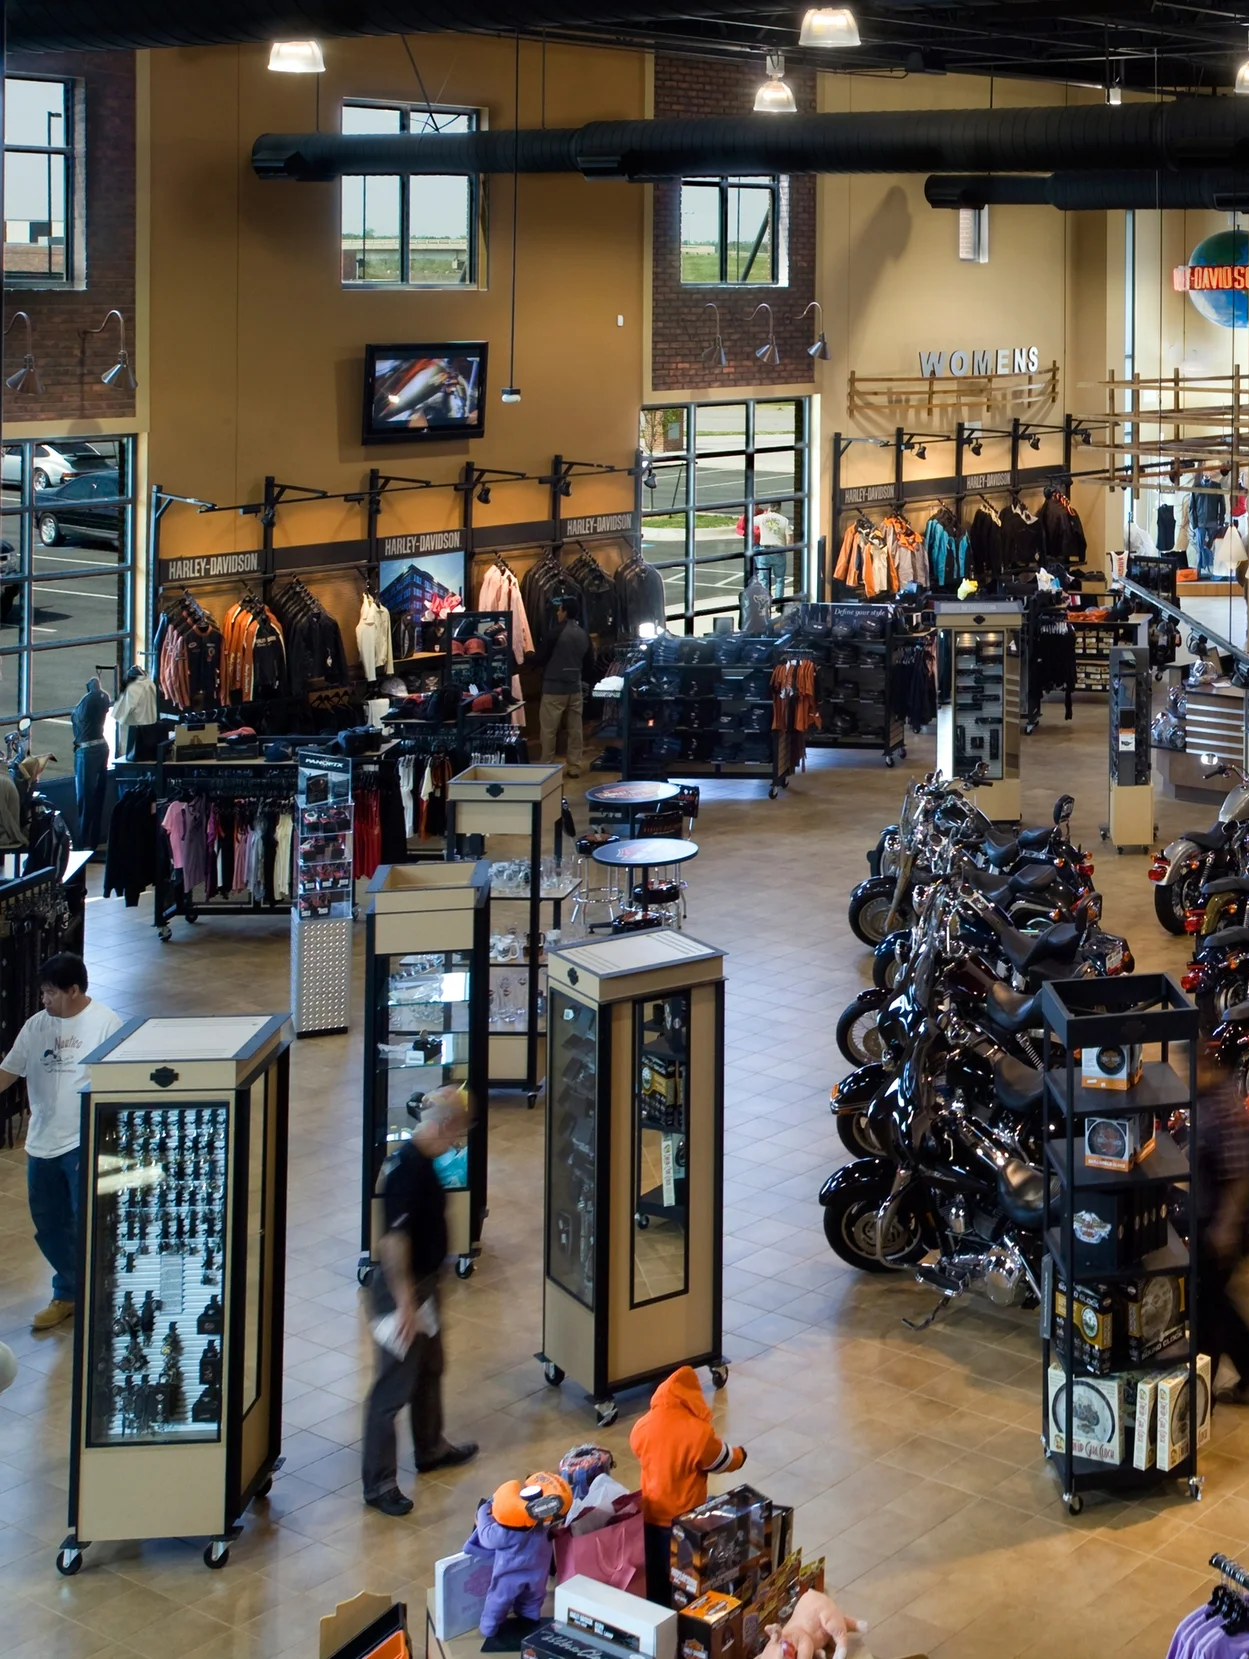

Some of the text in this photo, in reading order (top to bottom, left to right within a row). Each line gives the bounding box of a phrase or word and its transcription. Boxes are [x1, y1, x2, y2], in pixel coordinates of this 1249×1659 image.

[918, 346, 1039, 378] WOMENS
[967, 472, 1011, 489] HARLEY-DAVIDSON
[845, 485, 894, 503] HARLEY-DAVIDSON
[567, 513, 632, 536] HARLEY-DAVIDSON
[385, 531, 461, 556] HARLEY-DAVIDSON
[168, 552, 259, 580] HARLEY-DAVIDSON
[834, 607, 886, 618] Define your style
[305, 758, 344, 768] PANOPTX
